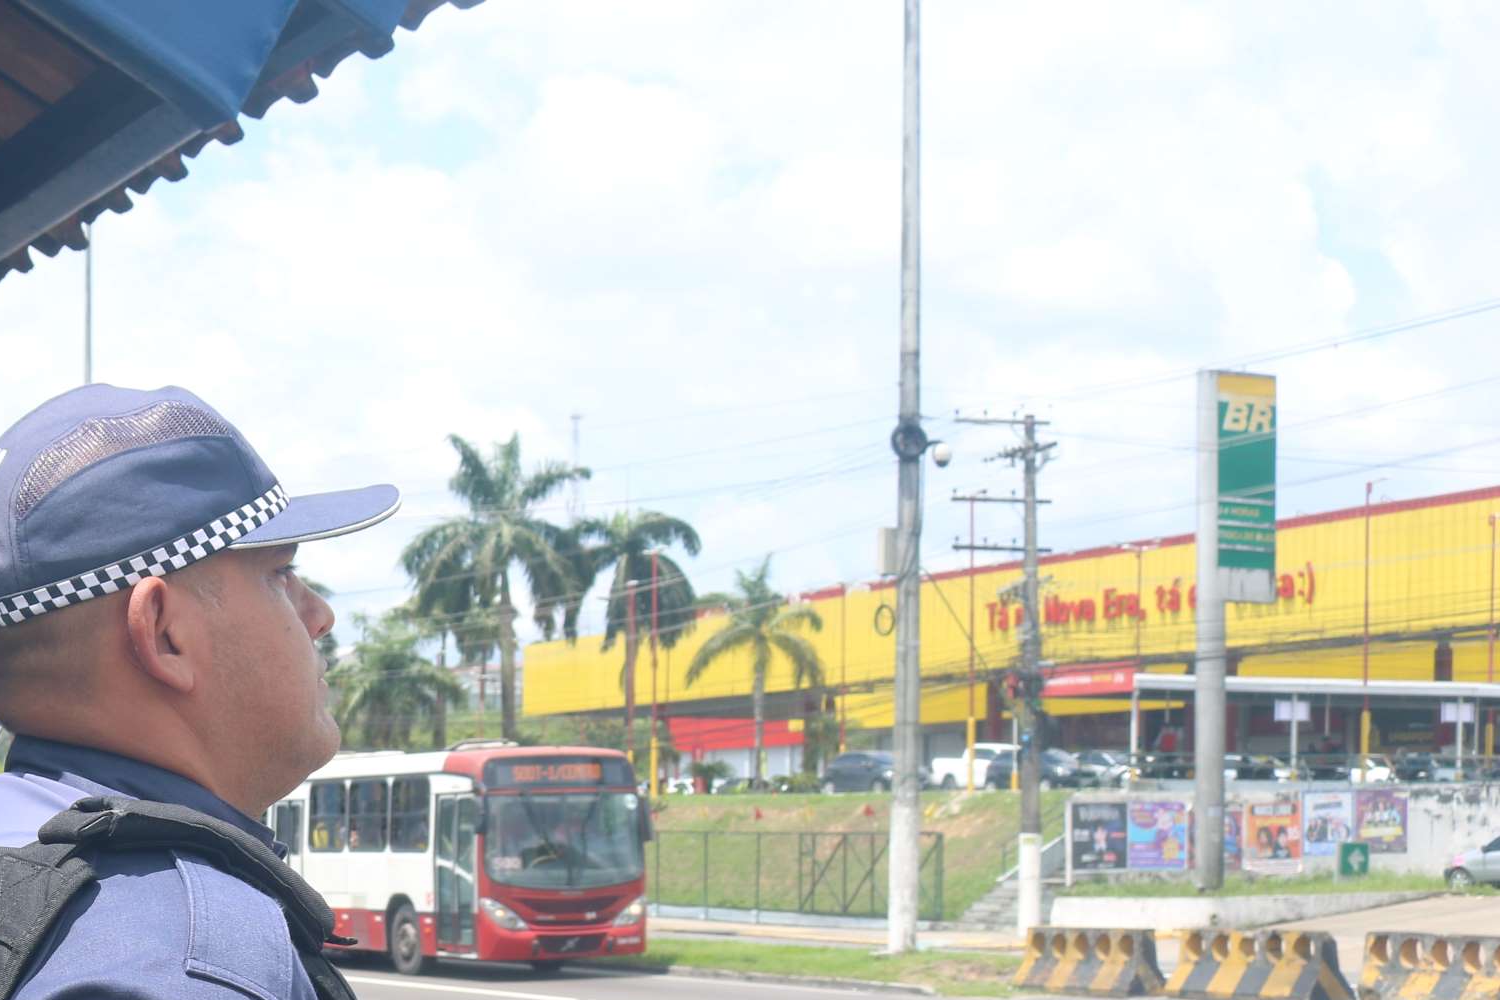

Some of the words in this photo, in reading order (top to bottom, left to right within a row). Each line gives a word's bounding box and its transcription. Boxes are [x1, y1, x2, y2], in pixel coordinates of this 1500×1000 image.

[1223, 398, 1272, 433] BR
[1044, 595, 1095, 626] Nova
[1156, 576, 1181, 613] tá
